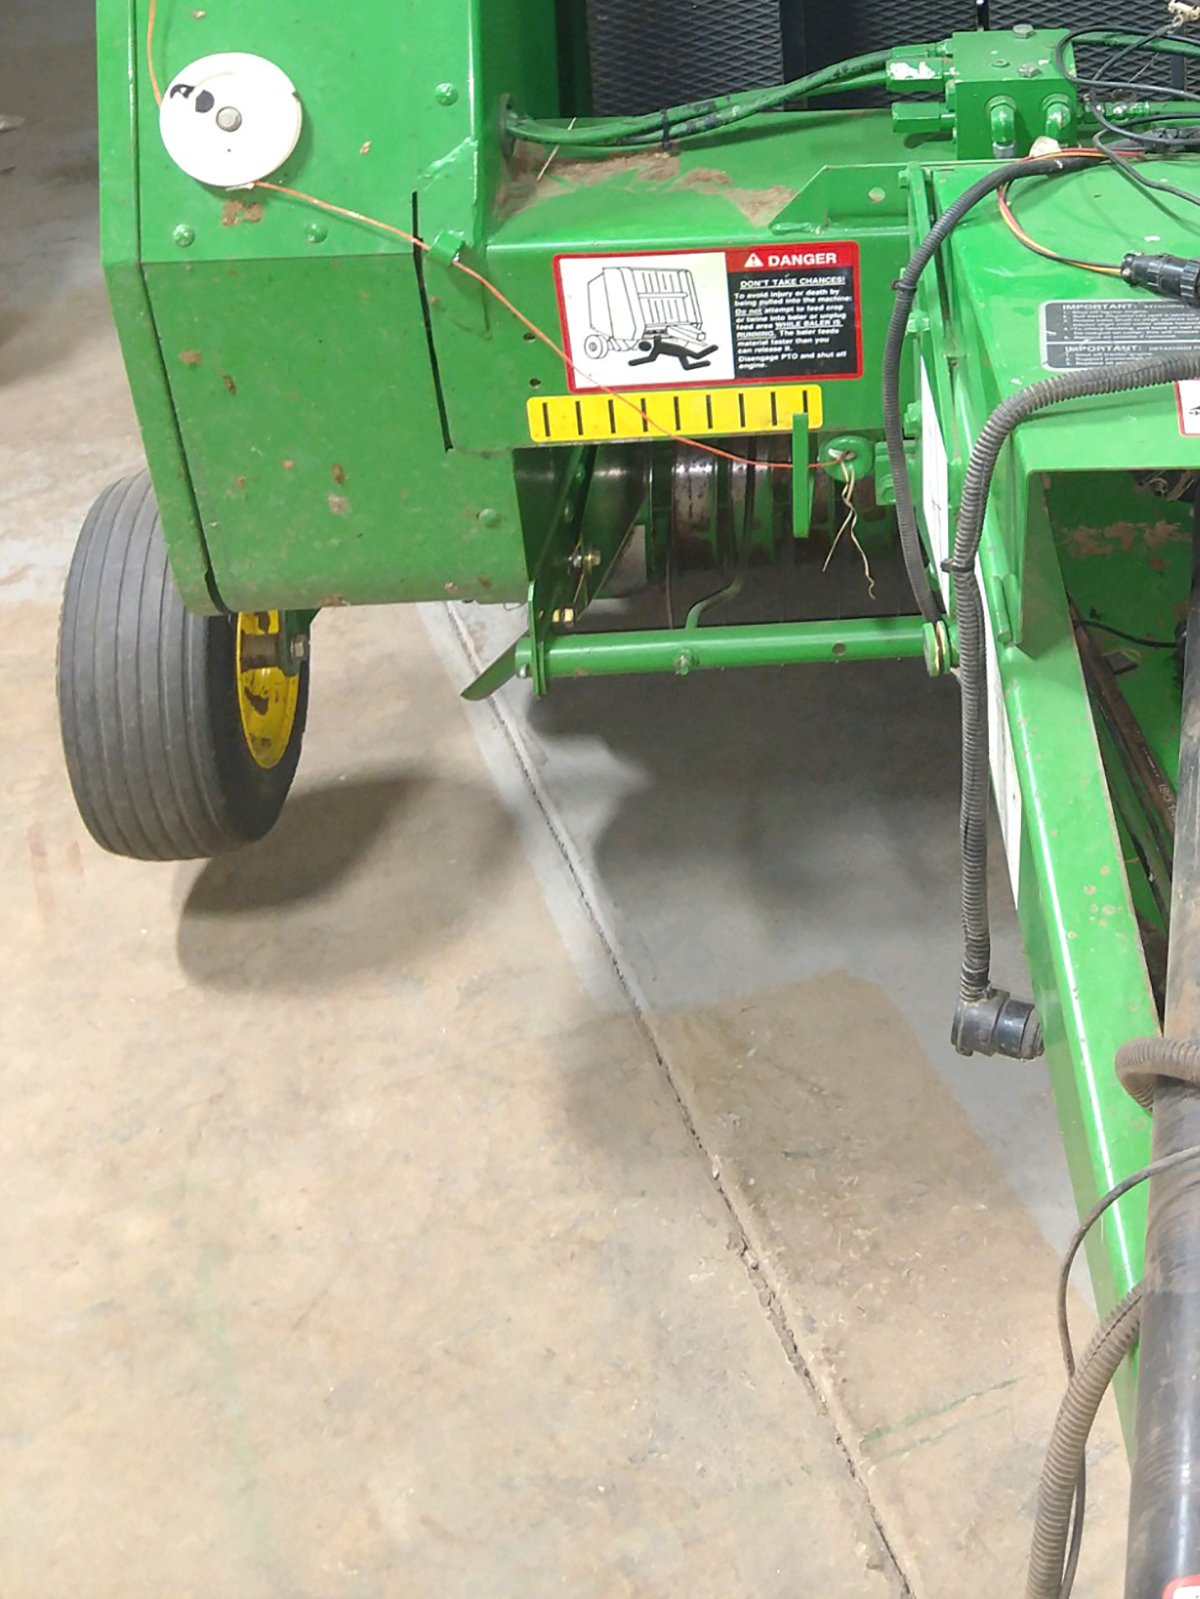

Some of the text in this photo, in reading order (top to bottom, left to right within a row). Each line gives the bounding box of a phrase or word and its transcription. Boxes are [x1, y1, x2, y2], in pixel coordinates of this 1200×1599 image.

[768, 253, 837, 267] DANGER
[740, 276, 846, 288] DON'T TAKE CHANCES!
[770, 291, 792, 300] injury
[815, 337, 829, 345] you
[738, 355, 779, 363] Disengage
